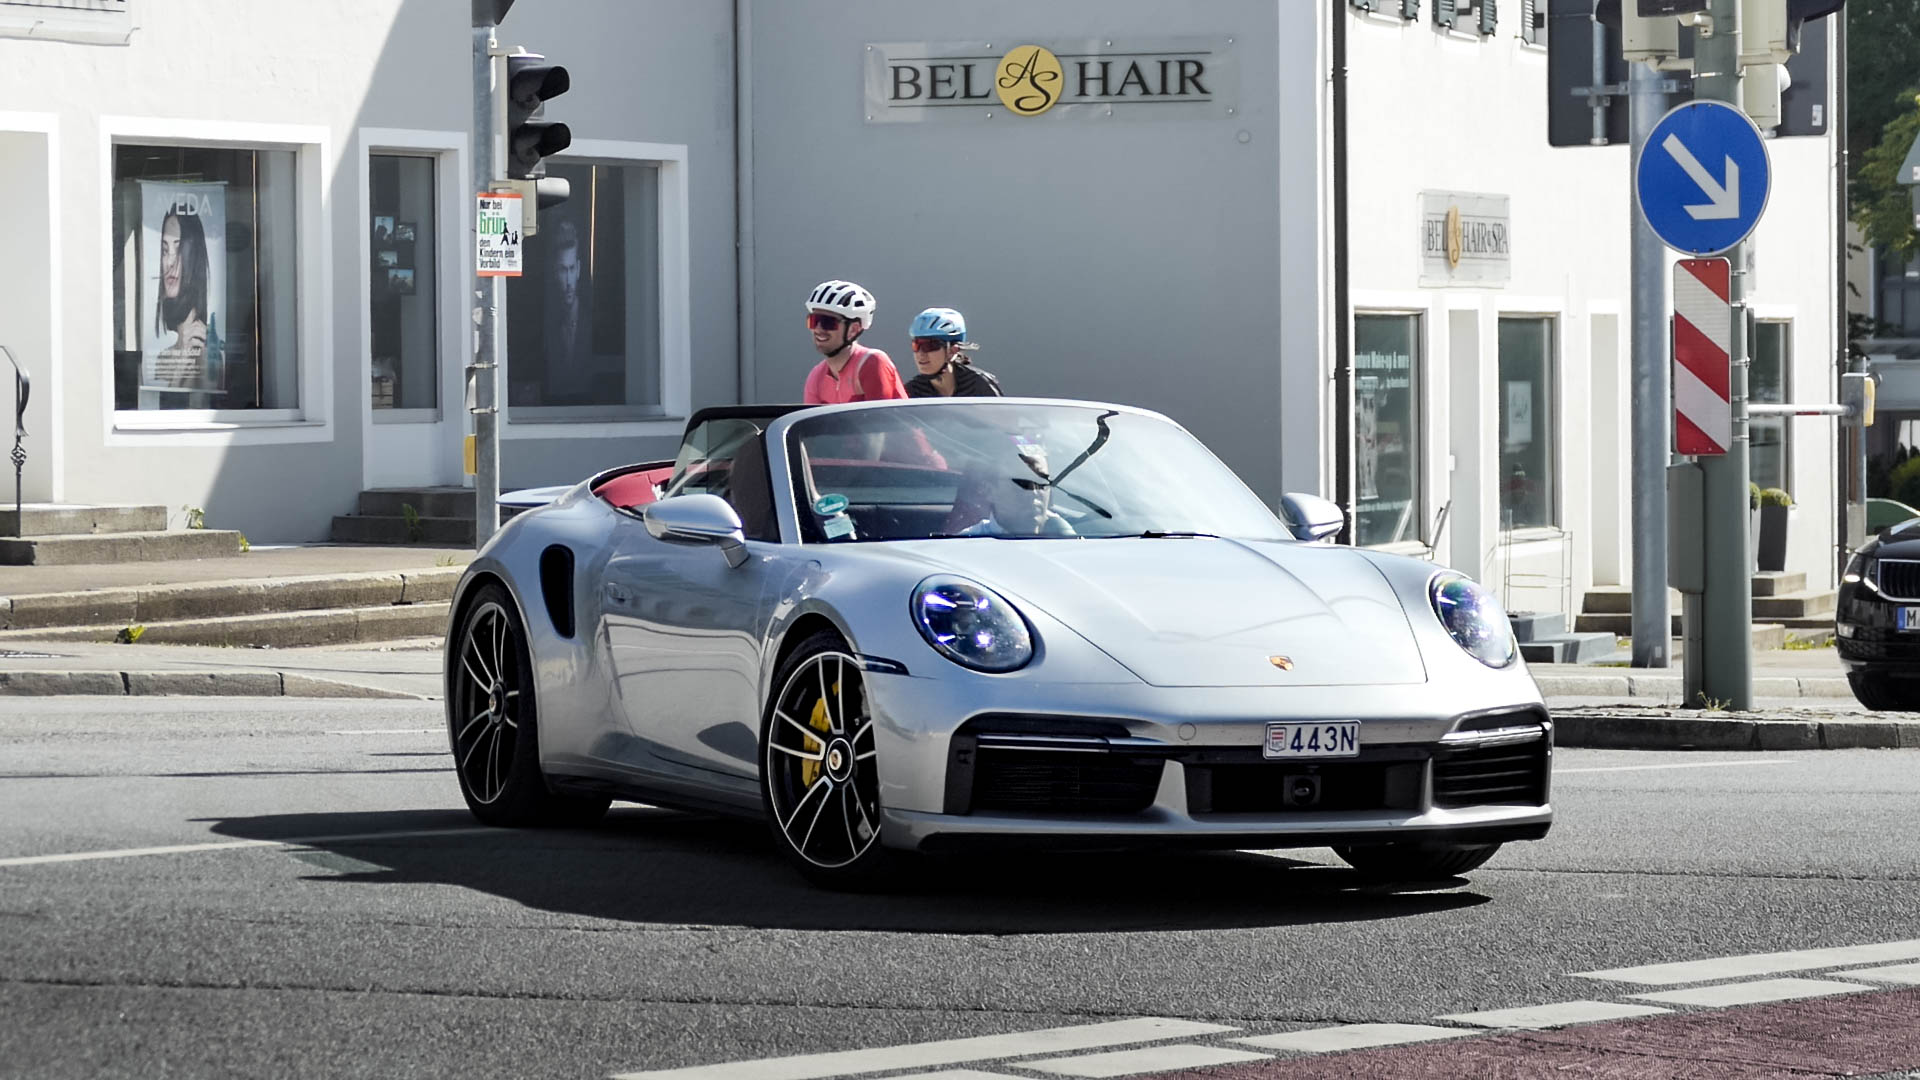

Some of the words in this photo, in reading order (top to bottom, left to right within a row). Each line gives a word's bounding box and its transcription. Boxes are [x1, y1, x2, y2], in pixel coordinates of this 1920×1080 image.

[888, 63, 991, 100] BEL
[1074, 58, 1212, 97] HAIR
[480, 200, 490, 209] Nur
[493, 200, 502, 209] bei
[480, 212, 505, 234] Grün
[1462, 221, 1488, 253] HAIR
[1492, 223, 1509, 253] SPA
[480, 249, 503, 257] Kindern
[480, 259, 500, 268] Vorbild
[1906, 609, 1917, 627] M
[1290, 725, 1355, 753] 443N
